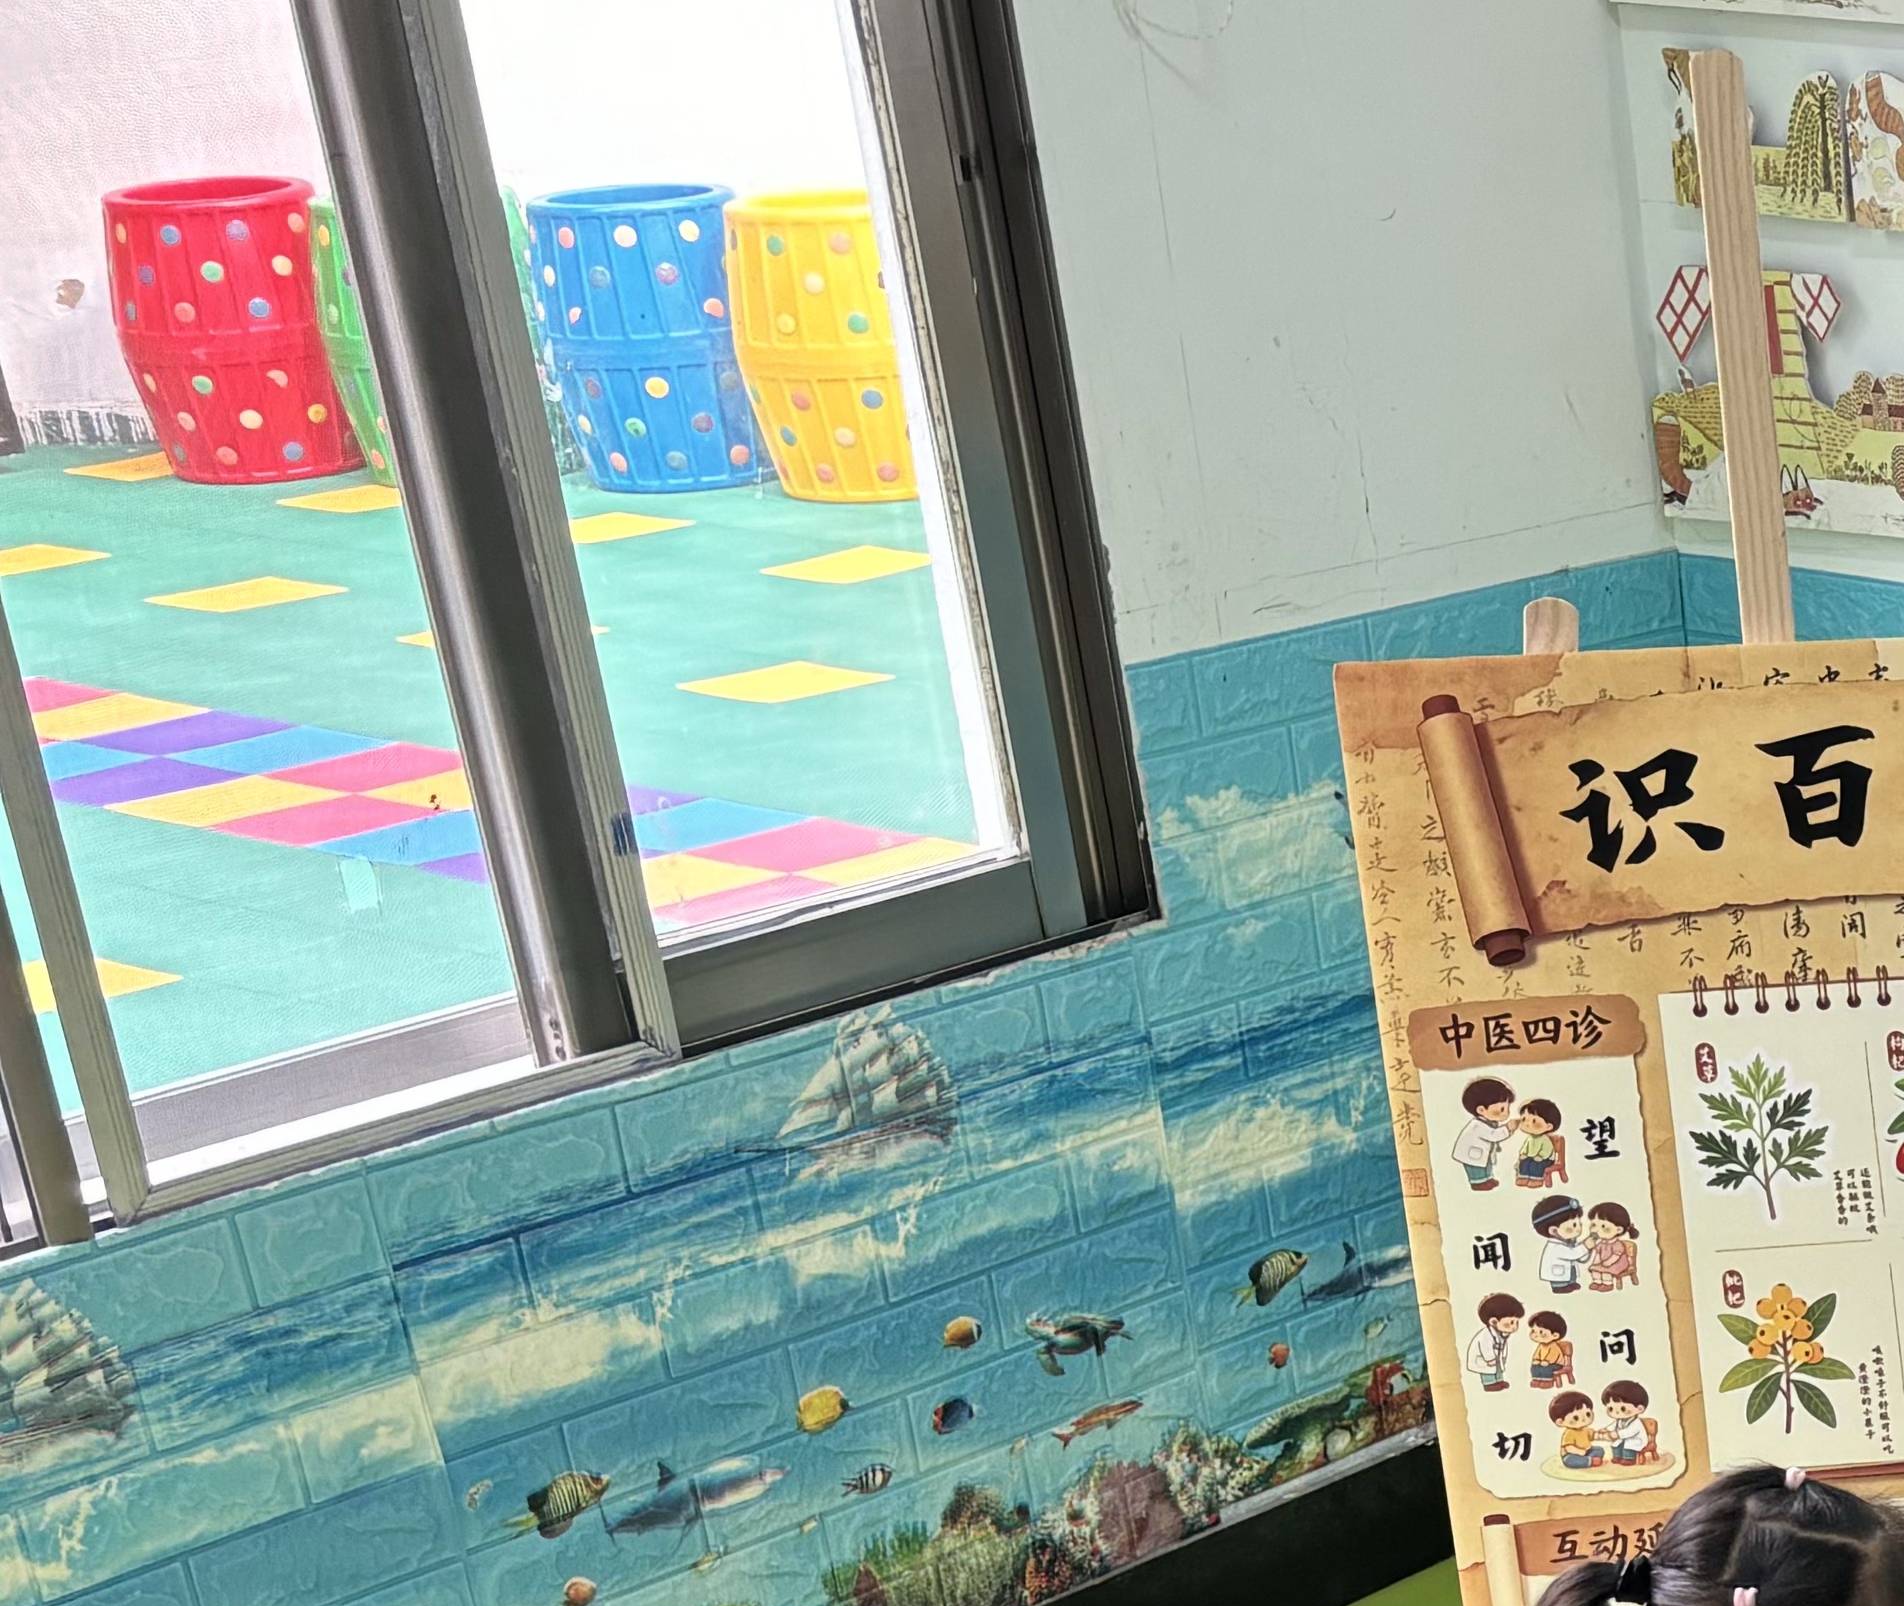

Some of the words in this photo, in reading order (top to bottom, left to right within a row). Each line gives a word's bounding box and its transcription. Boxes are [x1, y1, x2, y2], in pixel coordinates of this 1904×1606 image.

[1439, 1005, 1612, 1059] 中医四诊
[1699, 1046, 1716, 1082] 艾草
[1581, 1116, 1620, 1160] 望
[1472, 1232, 1511, 1272] 闻
[1599, 1328, 1637, 1365] 问
[1492, 1432, 1532, 1461] 切
